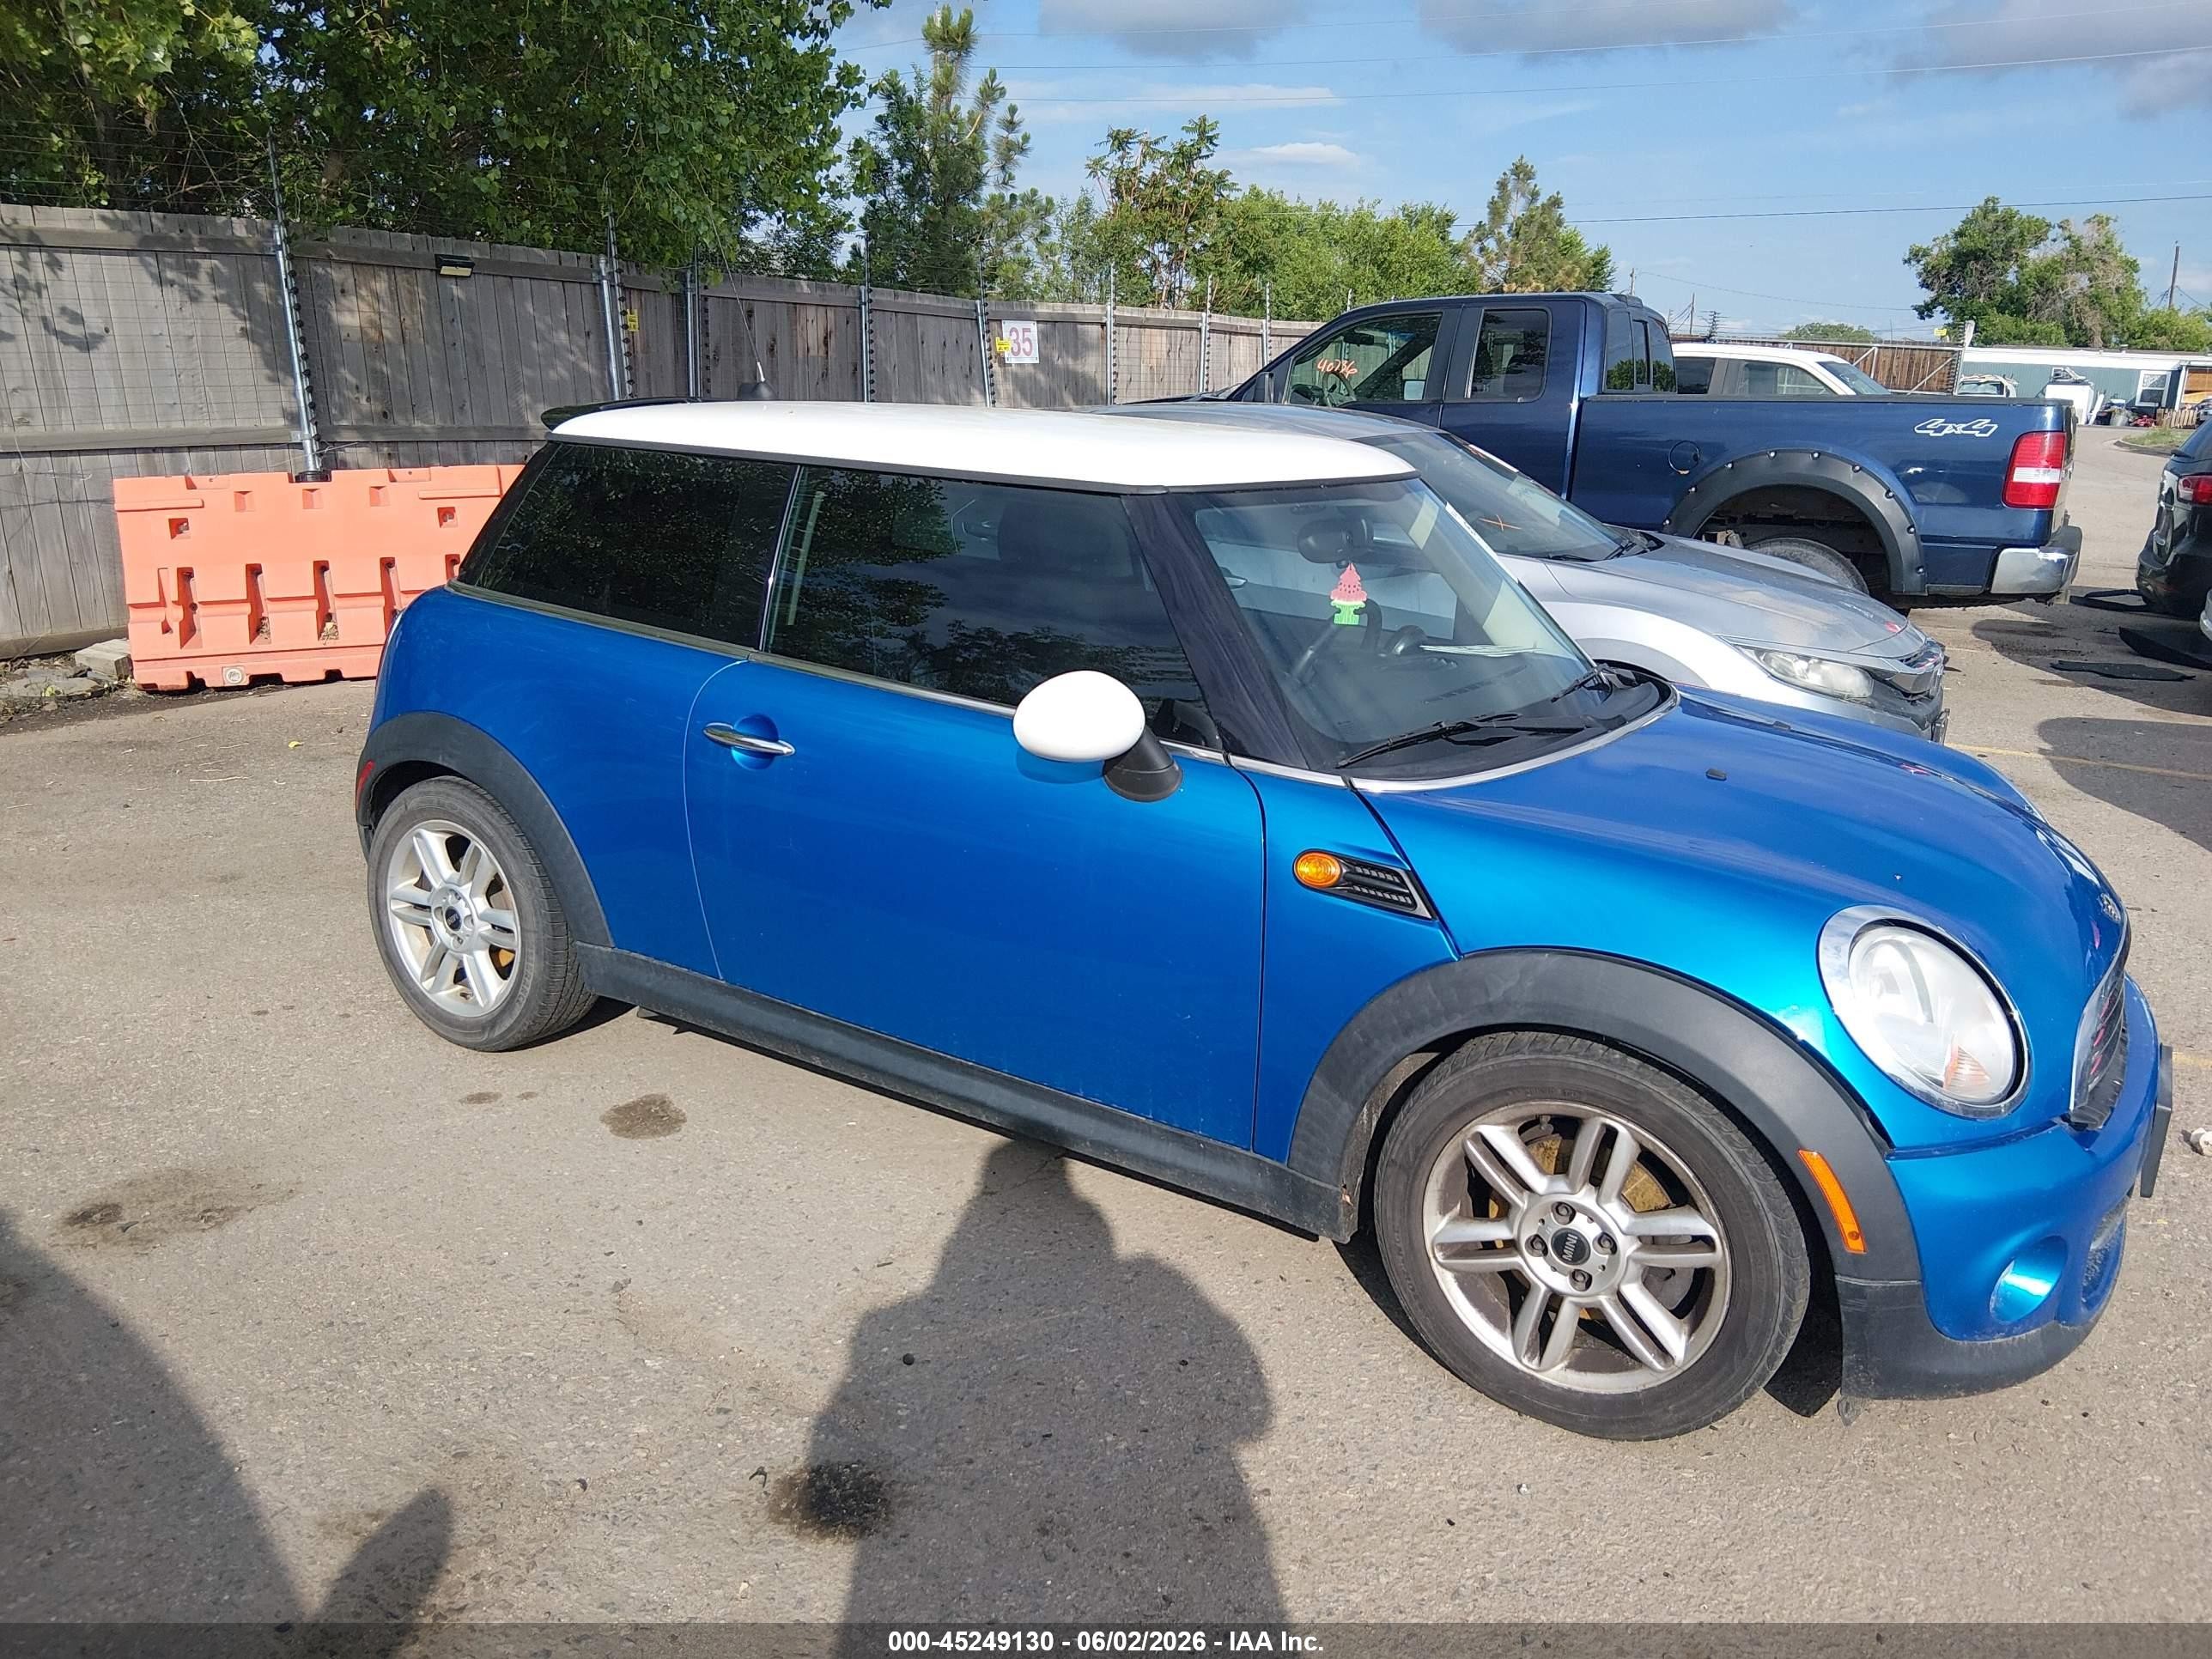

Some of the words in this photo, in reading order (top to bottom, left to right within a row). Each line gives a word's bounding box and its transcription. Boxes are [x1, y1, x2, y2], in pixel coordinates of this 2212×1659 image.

[1009, 327, 1033, 356] 35
[1914, 418, 1999, 437] 4x4
[1562, 1233, 1578, 1261] MINI
